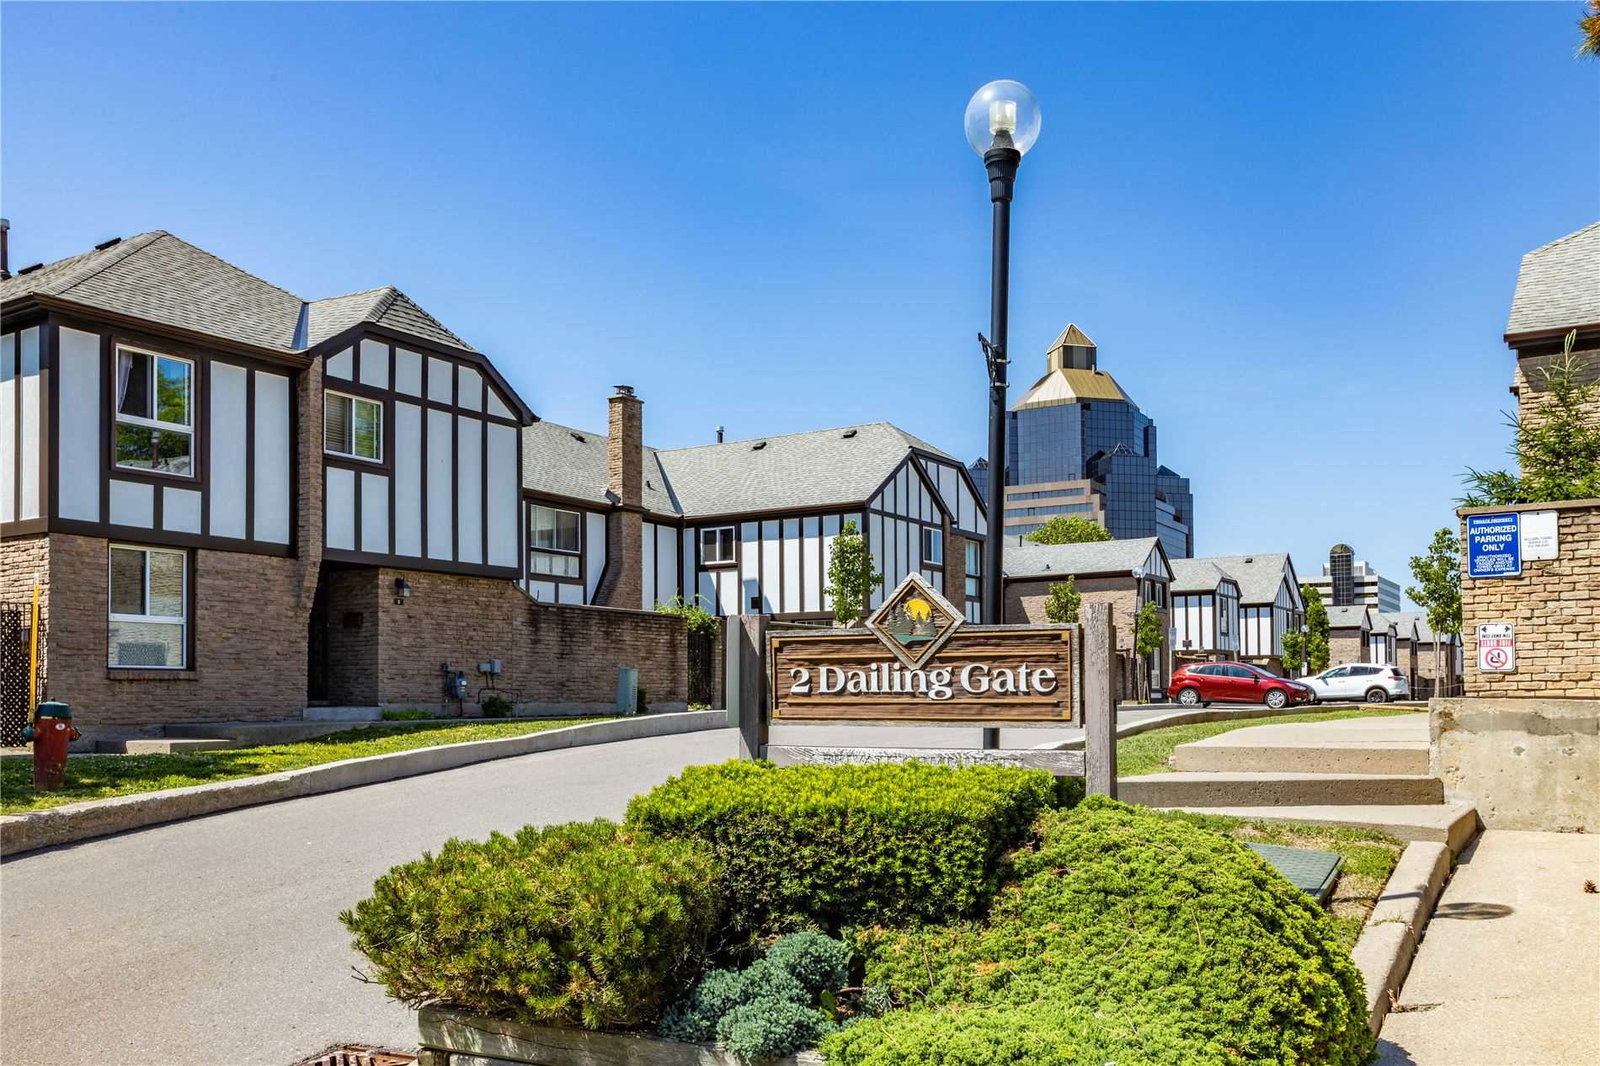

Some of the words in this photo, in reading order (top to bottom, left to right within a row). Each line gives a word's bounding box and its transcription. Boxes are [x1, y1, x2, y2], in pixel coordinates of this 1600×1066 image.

[1470, 525, 1517, 535] AUTHORIZED
[1475, 534, 1512, 543] PARKING
[1482, 543, 1505, 552] ONLY
[790, 667, 811, 693] 2
[818, 662, 953, 700] Dailing
[960, 662, 1057, 693] Gate
